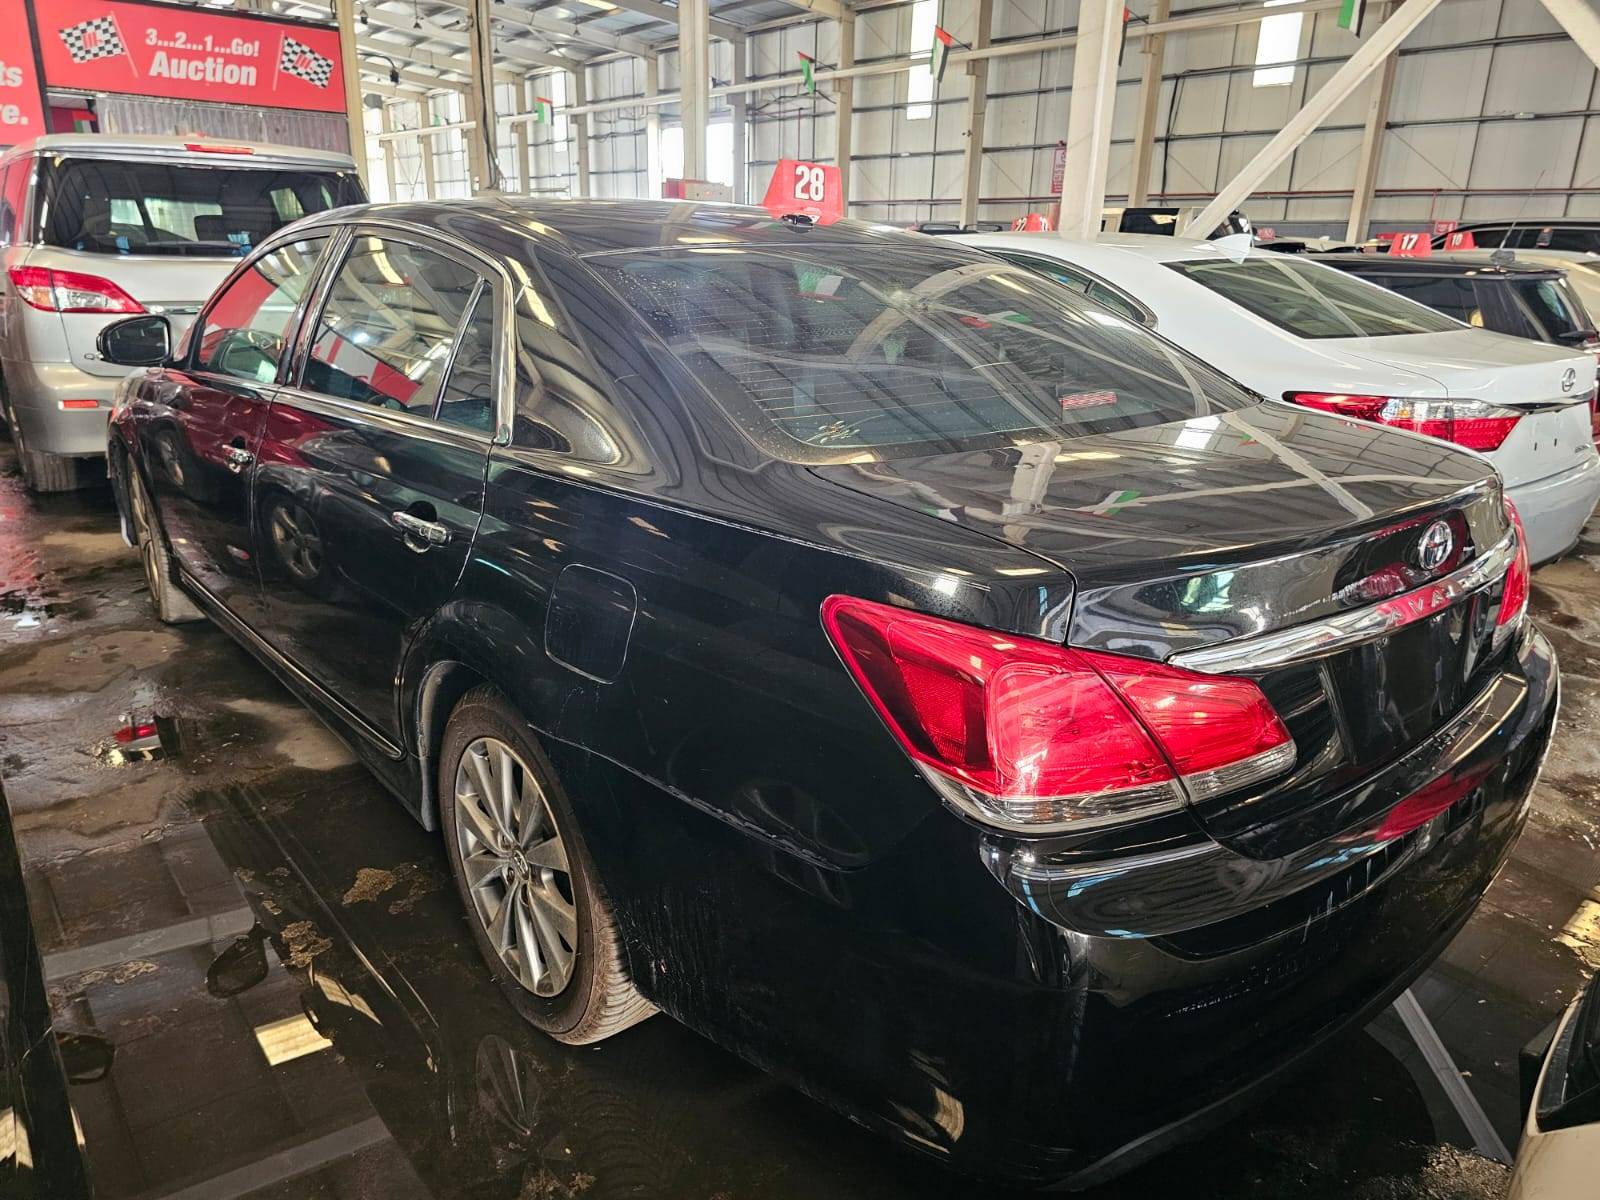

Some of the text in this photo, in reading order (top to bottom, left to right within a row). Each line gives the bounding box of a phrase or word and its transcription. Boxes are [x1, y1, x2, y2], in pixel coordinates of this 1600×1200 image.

[145, 28, 260, 58] 3...2...1...Go!
[148, 50, 257, 87] Auction
[0, 103, 29, 126] e.
[794, 164, 825, 202] 28
[1400, 233, 1419, 251] 17
